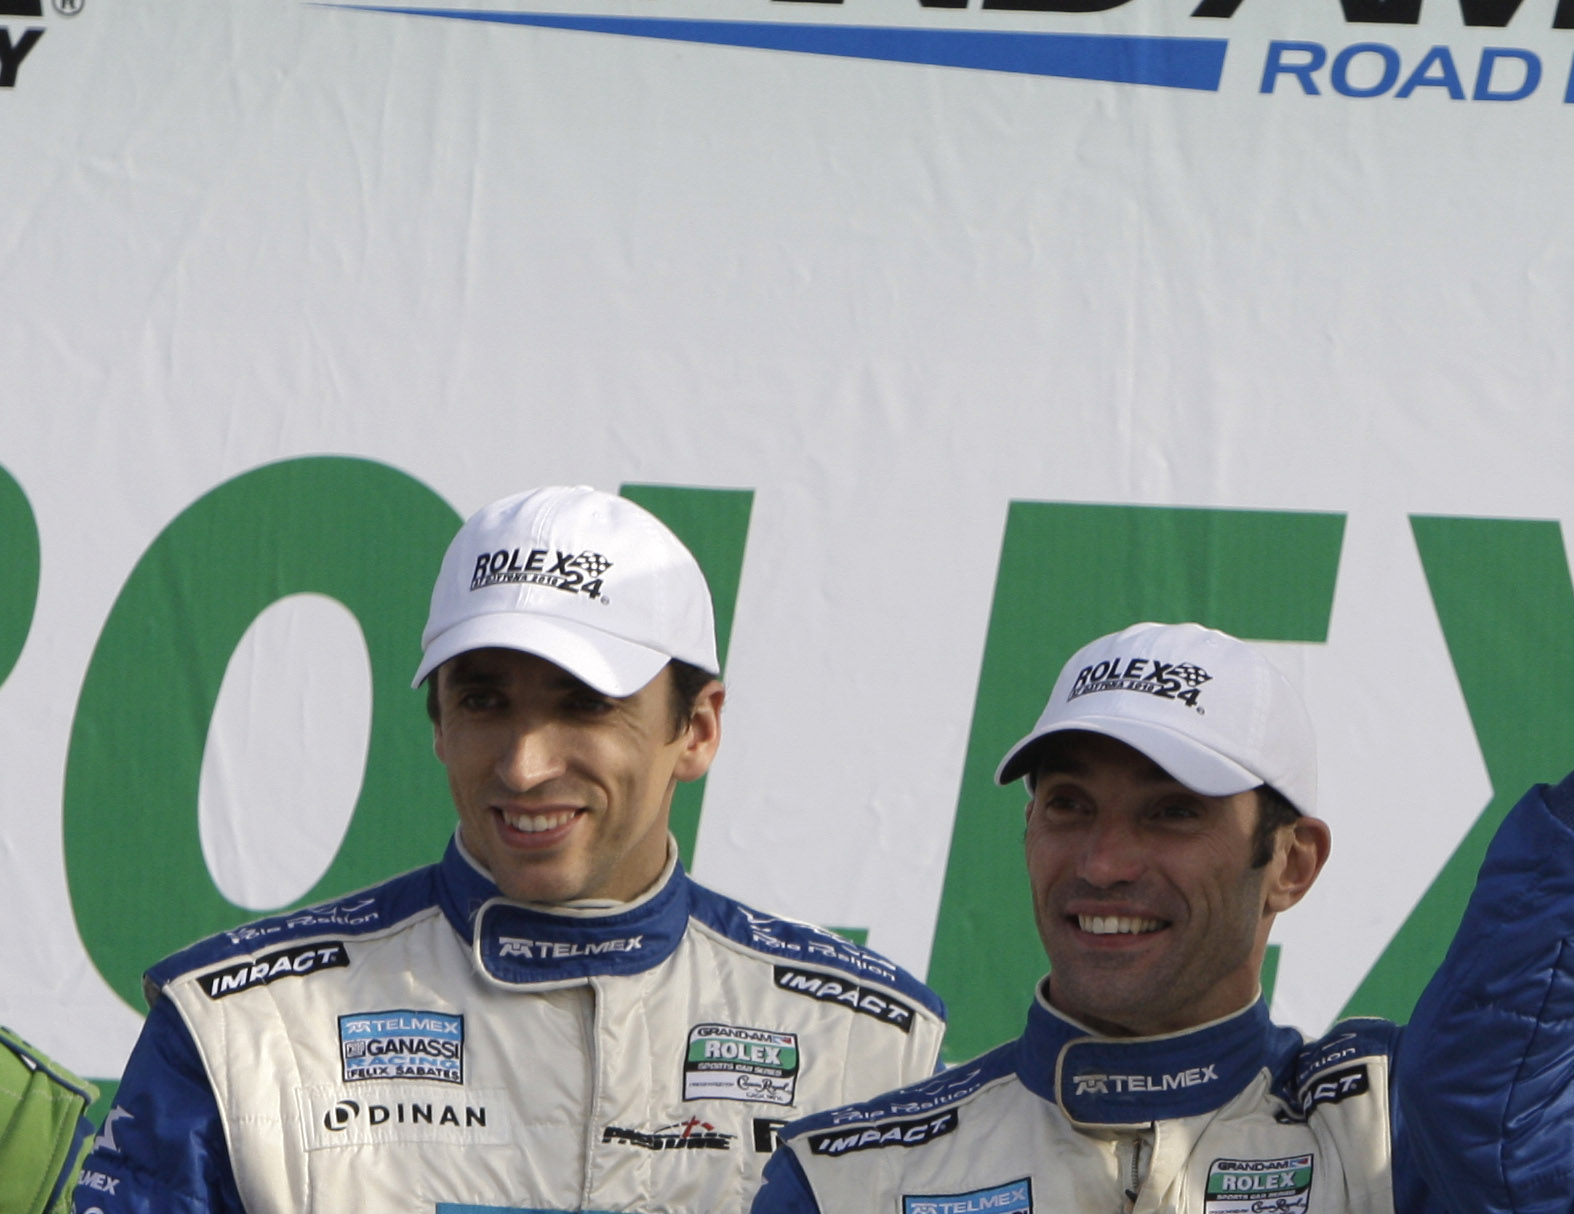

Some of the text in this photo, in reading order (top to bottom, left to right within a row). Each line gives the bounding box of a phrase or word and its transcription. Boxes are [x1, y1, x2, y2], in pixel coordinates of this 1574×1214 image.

[1259, 40, 1541, 103] ROAD
[472, 548, 604, 600] ROLEX 24
[1073, 657, 1201, 708] ROLEX 24
[538, 935, 644, 959] TELMEX
[210, 946, 340, 998] IMPACT
[780, 971, 909, 1022] IMPACT
[372, 1018, 458, 1035] TELMEX
[367, 1038, 459, 1060] GANASSI
[704, 1039, 781, 1065] ROLEX
[346, 1056, 459, 1069] RACING
[350, 1066, 460, 1081] FELIX SABATES
[1109, 1064, 1218, 1094] TELMEX
[368, 1102, 487, 1128] DINAN
[818, 1115, 951, 1152] IMPACT
[1222, 1171, 1296, 1191] ROLEX
[939, 1187, 1027, 1214] TELMEX
